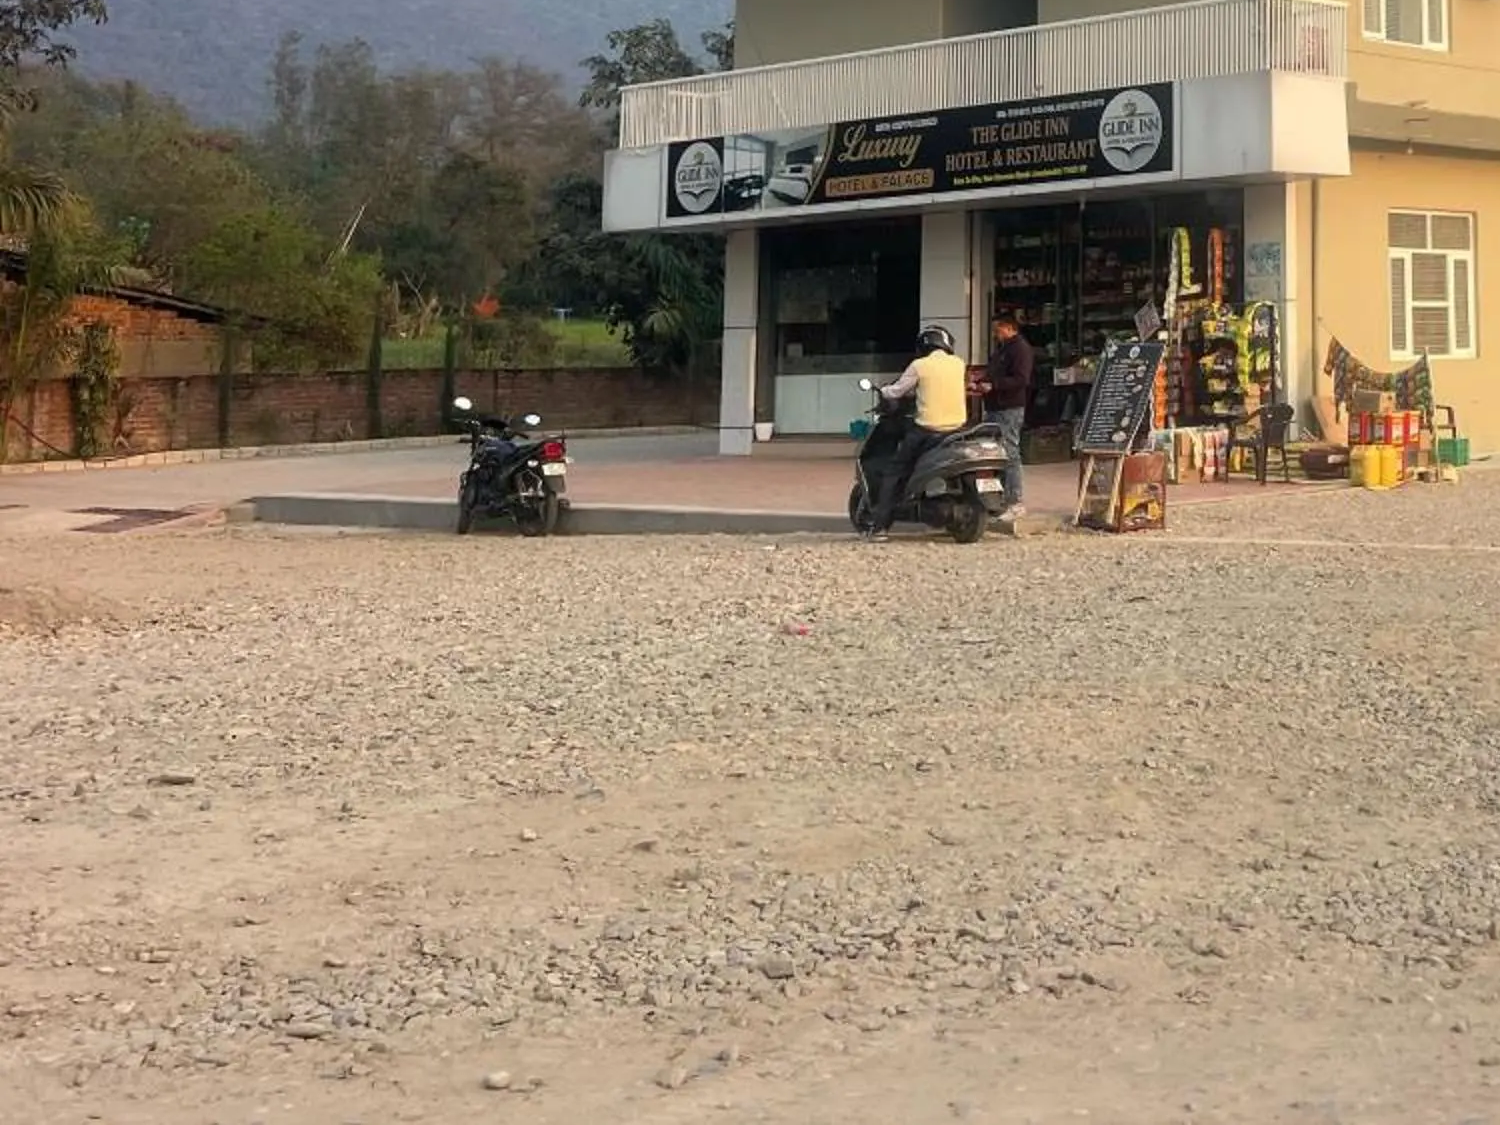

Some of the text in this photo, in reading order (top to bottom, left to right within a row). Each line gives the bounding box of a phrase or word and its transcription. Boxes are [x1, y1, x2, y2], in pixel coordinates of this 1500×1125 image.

[972, 116, 1070, 145] THE GLIDE INN
[1103, 119, 1135, 137] GLIDE
[838, 124, 921, 167] Luxury
[945, 150, 988, 172] HOTEL
[992, 149, 1003, 166] &
[1006, 139, 1096, 166] RESTAURANT
